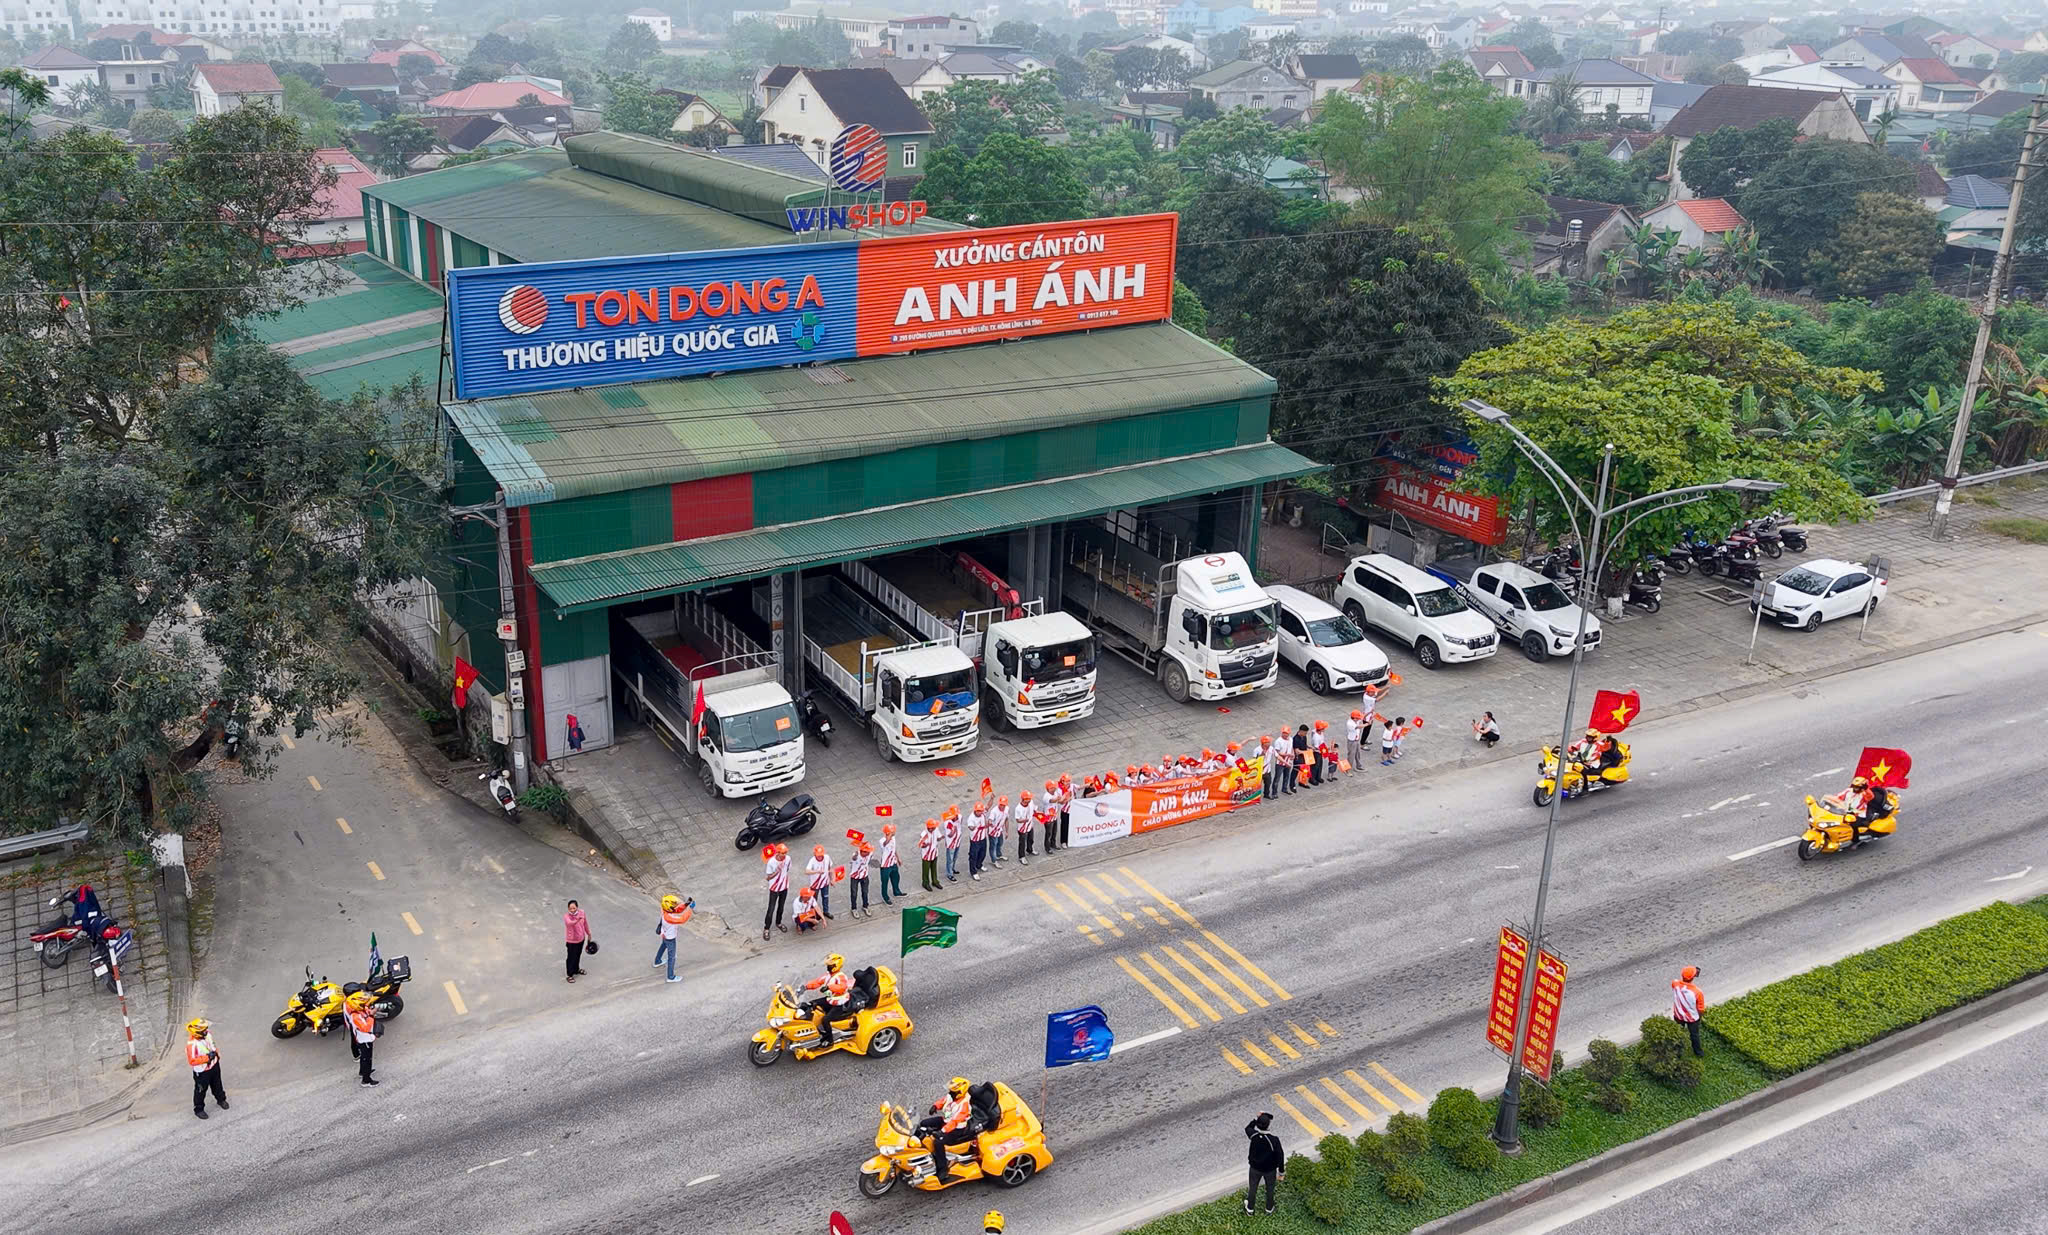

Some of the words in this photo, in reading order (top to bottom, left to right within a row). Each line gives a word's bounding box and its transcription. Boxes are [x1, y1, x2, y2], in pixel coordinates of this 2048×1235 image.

[785, 200, 928, 235] WINSHOP
[933, 239, 1015, 269] XƯỞNG
[564, 287, 659, 329] TON
[669, 277, 790, 322] DONG
[794, 274, 825, 310] A
[893, 276, 1018, 326] ANH
[1032, 260, 1147, 310] ÁNH
[502, 341, 608, 371] THƯƠNG
[614, 331, 665, 363] HIỆU
[672, 324, 736, 357] QUỐC
[743, 325, 780, 348] GIA
[1384, 477, 1429, 505] ANH
[1432, 490, 1480, 523] ÁNH
[1149, 795, 1177, 816] ANH
[1182, 789, 1209, 807] ÁNH
[1076, 825, 1094, 834] TON
[1095, 820, 1119, 831] DONG
